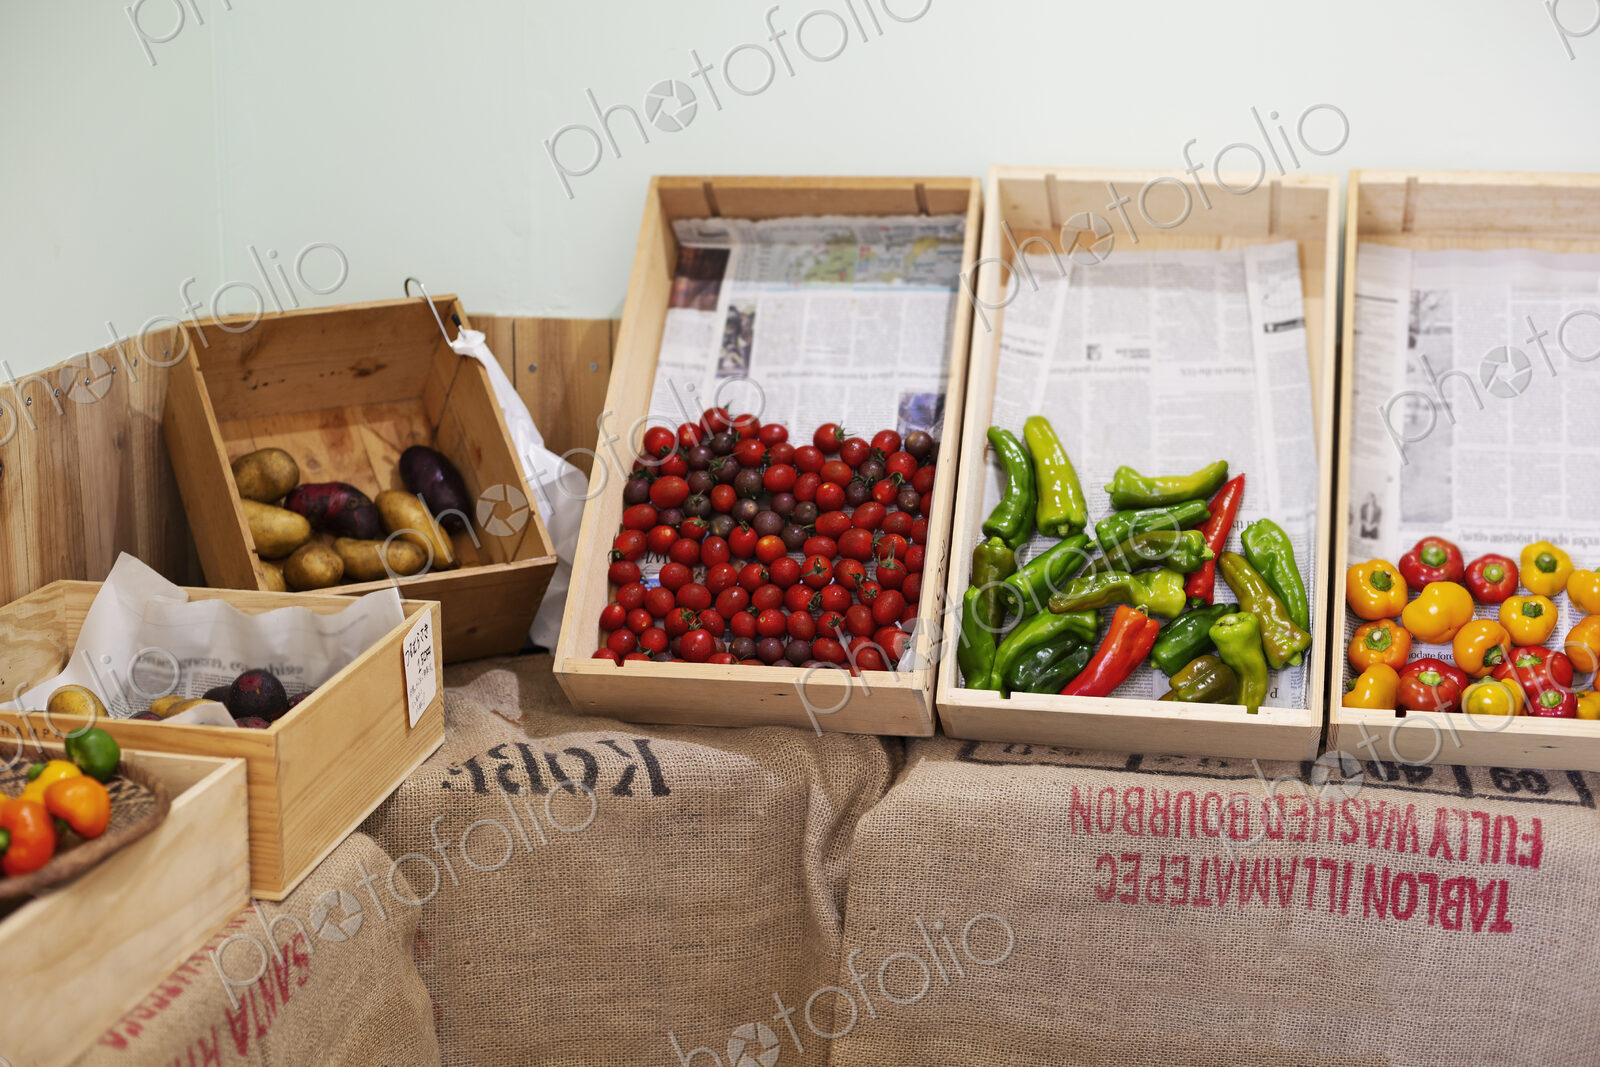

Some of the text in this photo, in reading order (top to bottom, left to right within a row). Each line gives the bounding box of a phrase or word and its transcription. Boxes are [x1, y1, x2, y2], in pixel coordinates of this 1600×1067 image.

[1070, 785, 1543, 869] FULLY WASHED BOURBON
[1095, 852, 1512, 934] TABLON ILLAMATEPEC
